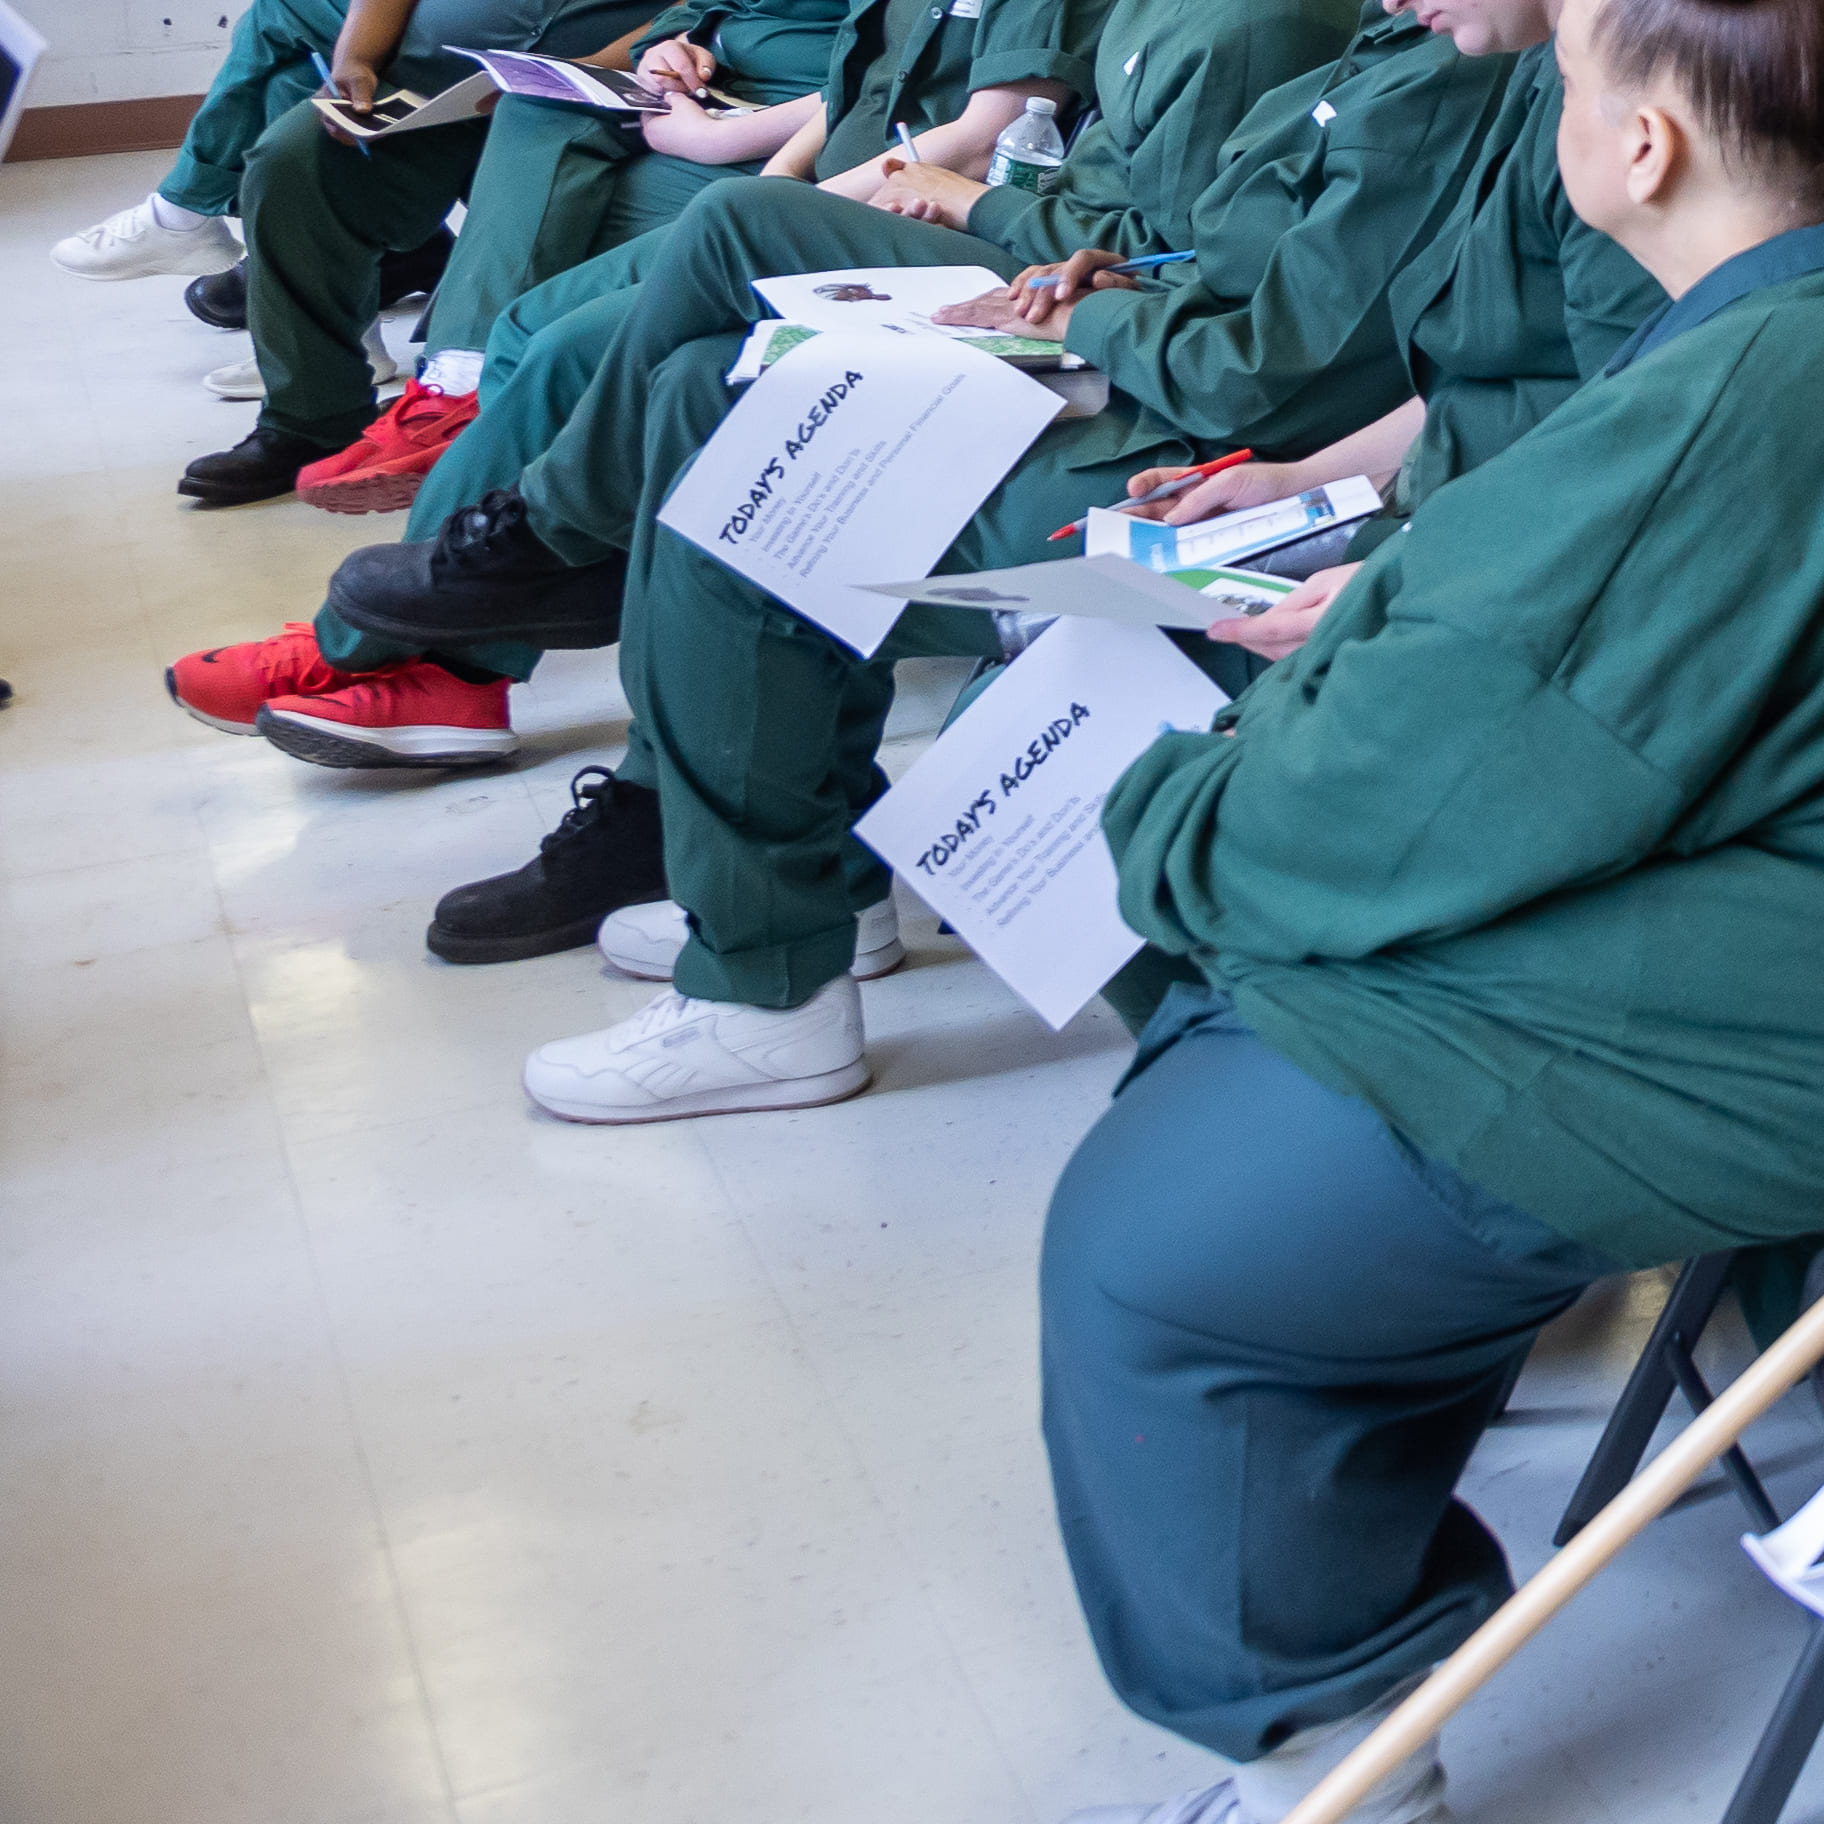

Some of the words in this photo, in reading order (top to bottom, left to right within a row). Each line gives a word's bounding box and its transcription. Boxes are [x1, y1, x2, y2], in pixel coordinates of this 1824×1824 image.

[717, 459, 790, 545] TODAY'S
[783, 366, 861, 459] AGENDA
[916, 791, 1000, 875] TODAY'S
[995, 701, 1089, 795] AGENDA
